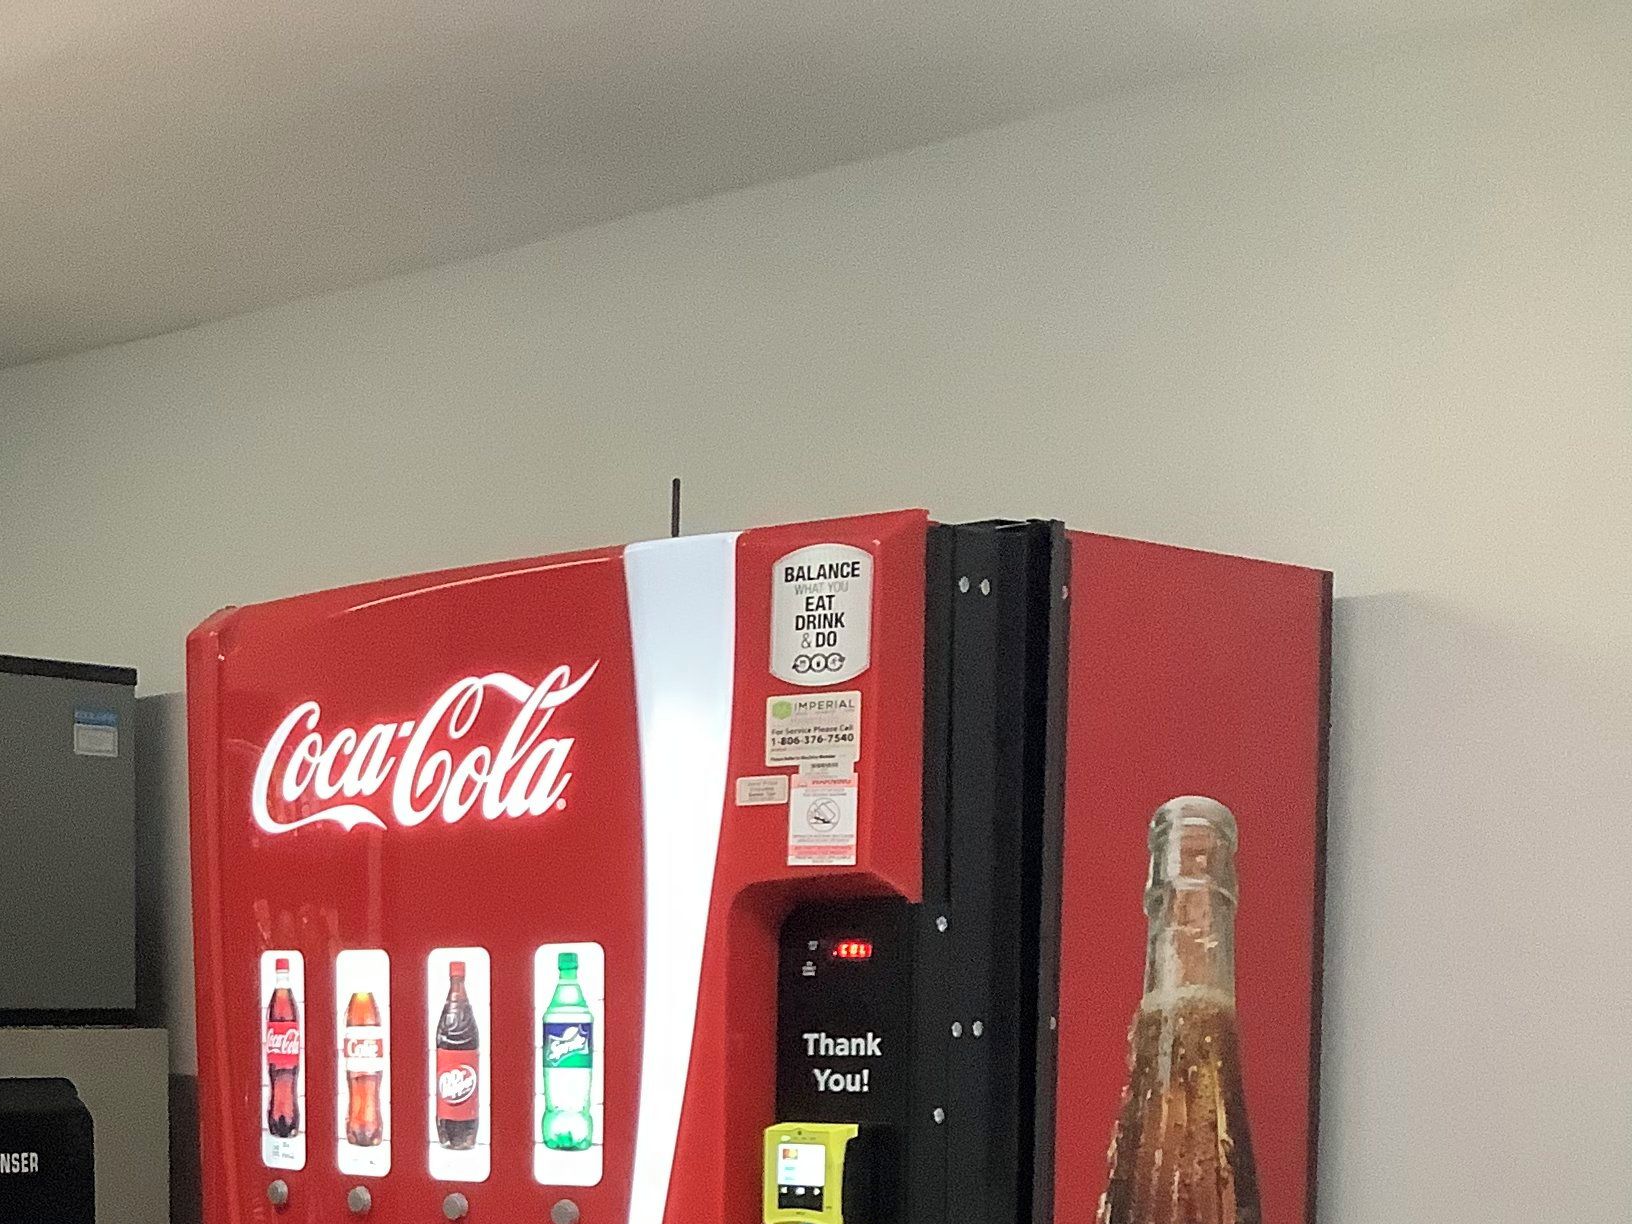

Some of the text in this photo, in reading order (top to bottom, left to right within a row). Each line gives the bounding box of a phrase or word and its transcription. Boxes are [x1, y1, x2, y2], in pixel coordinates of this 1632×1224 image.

[784, 561, 860, 583] BALANCE
[795, 581, 849, 595] WHAT YOU
[805, 594, 835, 612] EAT
[795, 612, 845, 631] DRINK
[801, 630, 837, 648] & DO
[794, 699, 855, 711] IMPERIAL
[786, 727, 811, 735] Service
[839, 724, 853, 732] Call
[251, 659, 600, 834] Coca-Cola
[771, 733, 854, 746] 1-806-376-7540
[802, 1031, 882, 1056] Thank
[813, 1068, 870, 1092] You!
